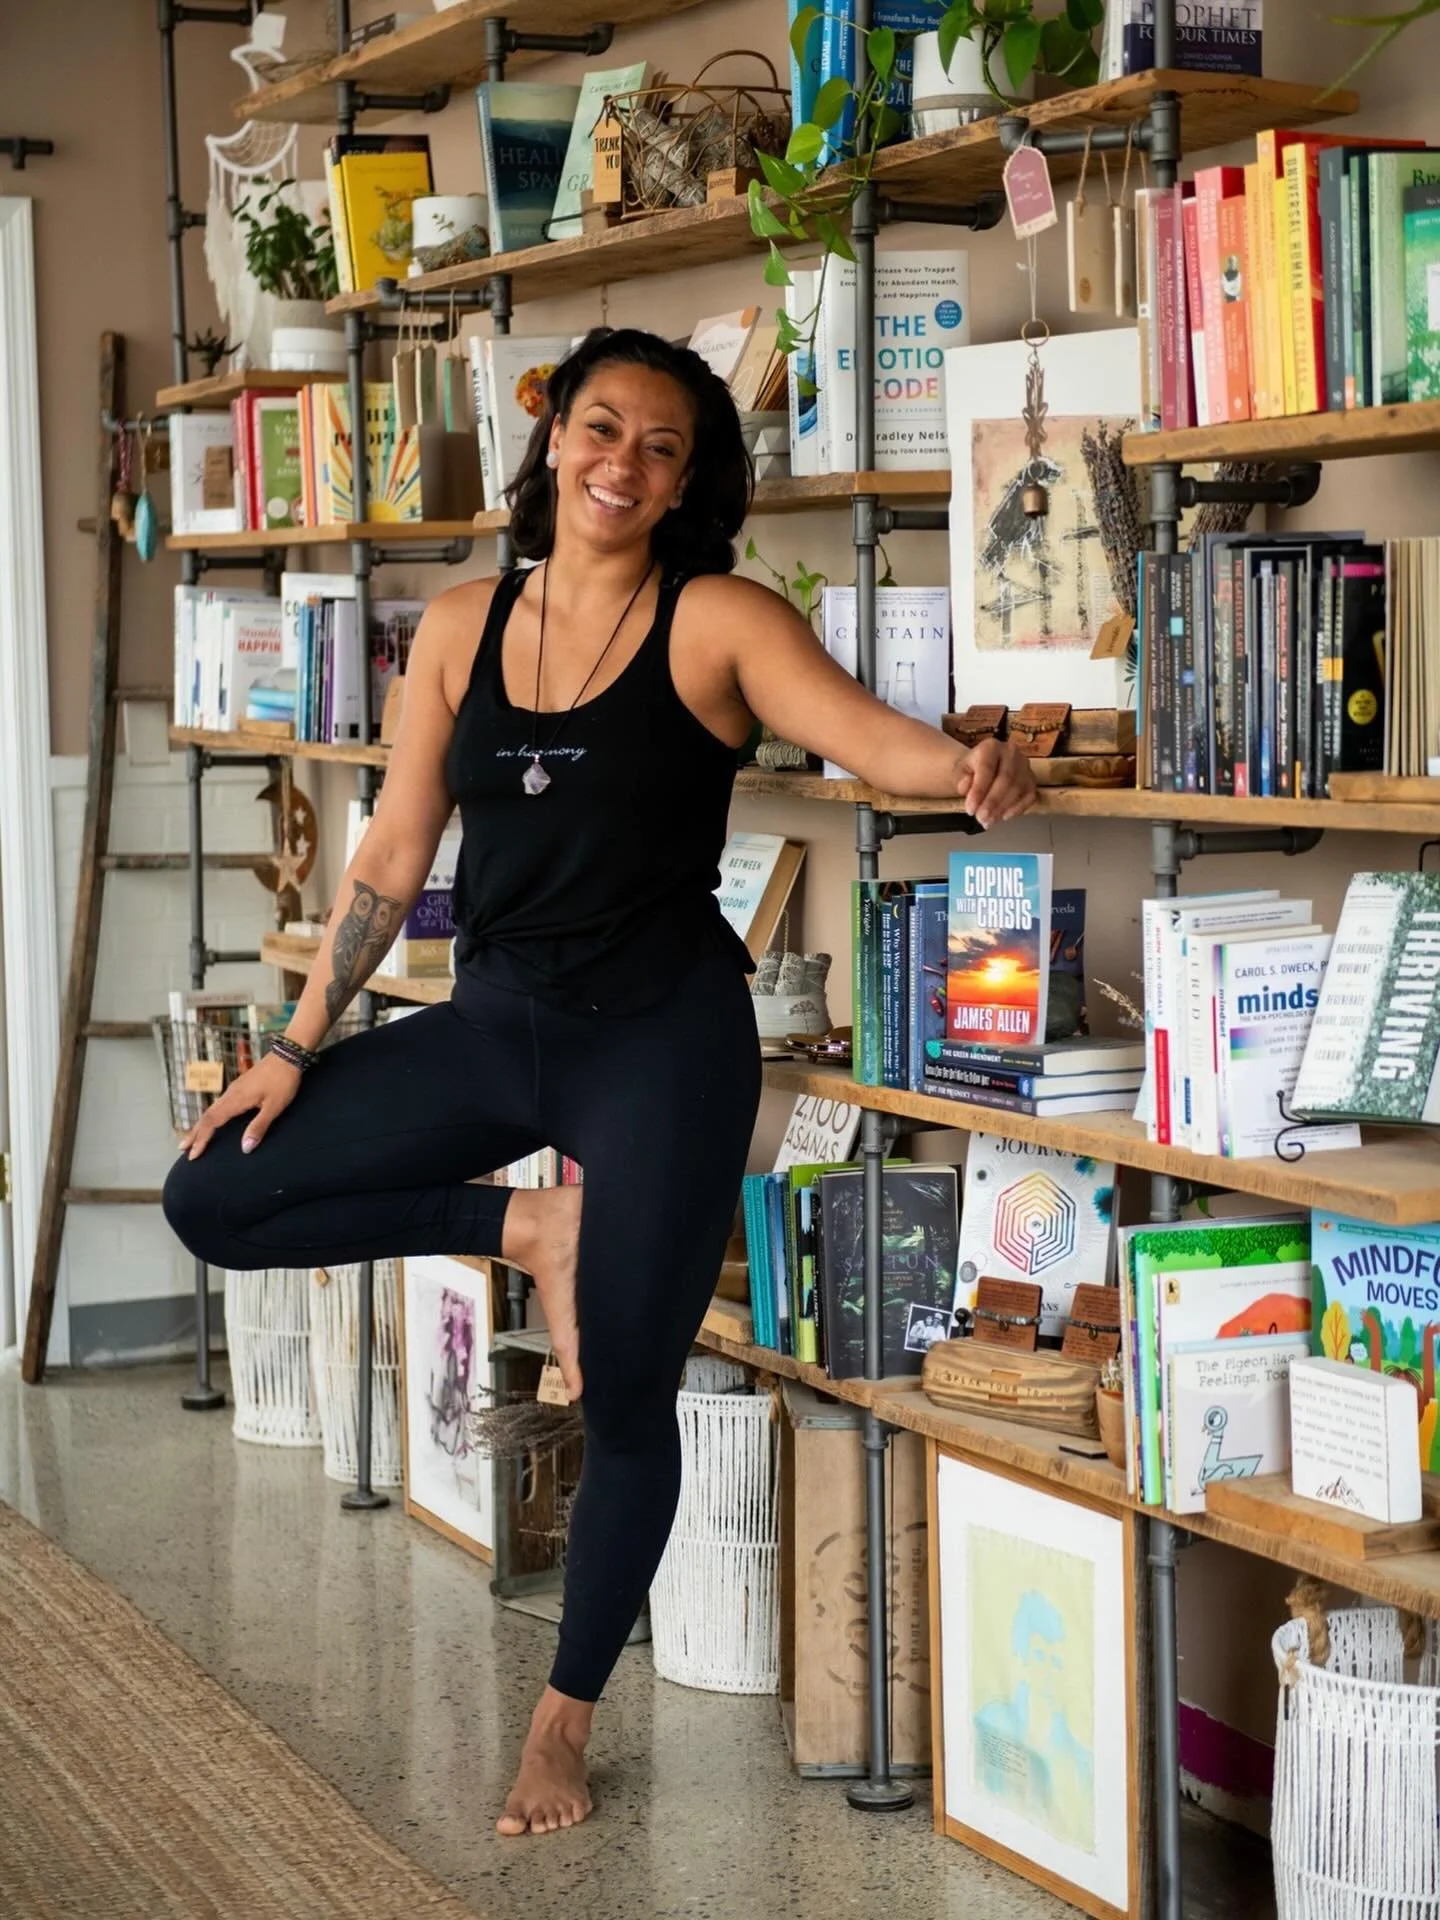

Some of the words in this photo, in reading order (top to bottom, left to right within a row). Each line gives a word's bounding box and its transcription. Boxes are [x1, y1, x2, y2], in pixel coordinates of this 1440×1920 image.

[878, 12, 909, 24] Transform
[912, 15, 926, 25] Your
[1142, 3, 1257, 29] POPHET
[1213, 29, 1257, 45] TIMES
[821, 41, 831, 71] PIVOT
[500, 146, 562, 165] HEALI
[1286, 157, 1301, 233] UNIVERSAL
[904, 266, 922, 274] Your
[924, 265, 956, 276] Trapped
[1290, 241, 1303, 290] HUMAN
[891, 279, 927, 287] Abundant
[931, 278, 960, 288] Health,
[883, 291, 897, 299] and
[899, 290, 940, 300] Happiness
[875, 315, 927, 337] THE
[837, 347, 945, 371] EOTIO
[472, 367, 485, 425] WISDOM
[874, 377, 939, 401] CODE
[876, 430, 915, 445] radley
[918, 430, 949, 441] Nels
[480, 446, 490, 478] WILD
[1235, 559, 1243, 577] THE
[881, 609, 929, 618] BEING
[238, 627, 281, 638] Stumbl
[835, 626, 944, 640] CRTAIN
[237, 639, 281, 653] HAPPIN
[1280, 681, 1288, 721] Moody
[1324, 719, 1332, 756] GROUT
[496, 747, 516, 757] in
[728, 856, 763, 871] BETWEEN
[729, 877, 747, 889] TWO
[963, 865, 1025, 899] COPING
[720, 895, 749, 910] GDOMS
[934, 910, 949, 922] Th
[955, 898, 977, 914] WITH
[976, 897, 1033, 931] CRISIS
[893, 928, 901, 949] Why
[894, 951, 901, 966] We
[1235, 966, 1267, 979] CAROL
[1269, 964, 1278, 976] S.
[1281, 960, 1319, 975] DWECK,
[893, 967, 901, 993] Sleep
[1238, 982, 1320, 1014] minds
[953, 1006, 993, 1032] JAMES
[997, 1008, 1031, 1035] ALLEN
[1218, 988, 1227, 1039] mindset
[1267, 1010, 1308, 1020] PSYCHOLOGY
[942, 1048, 952, 1057] THE
[952, 1050, 969, 1059] GREEN
[969, 1052, 1002, 1063] AMENDMENT
[785, 1125, 840, 1164] ASANAS
[843, 1253, 940, 1273] STUN
[1331, 1243, 1440, 1288] MINDF
[1366, 1279, 1439, 1312] MOVES
[1195, 1360, 1220, 1373] The
[1224, 1354, 1269, 1372] Pigeon
[1271, 1352, 1297, 1366] Has
[1199, 1373, 1261, 1388] Feelings,
[1265, 1368, 1290, 1381] Too
